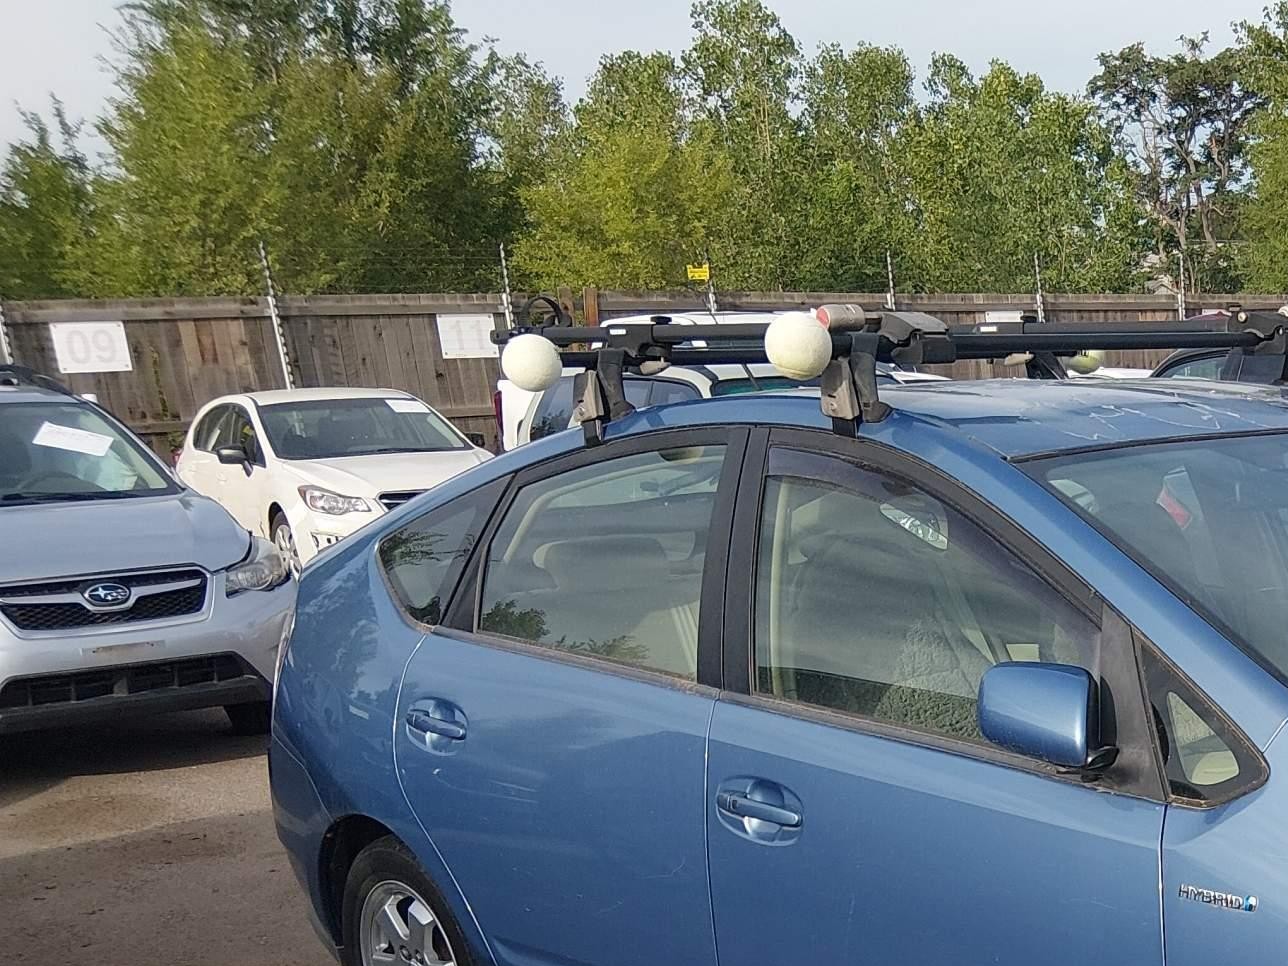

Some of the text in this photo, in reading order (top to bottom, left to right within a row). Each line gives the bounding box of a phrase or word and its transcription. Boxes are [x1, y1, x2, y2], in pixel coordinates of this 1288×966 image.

[66, 329, 116, 364] 09
[449, 319, 485, 351] 11
[1178, 883, 1243, 910] HYBRID
